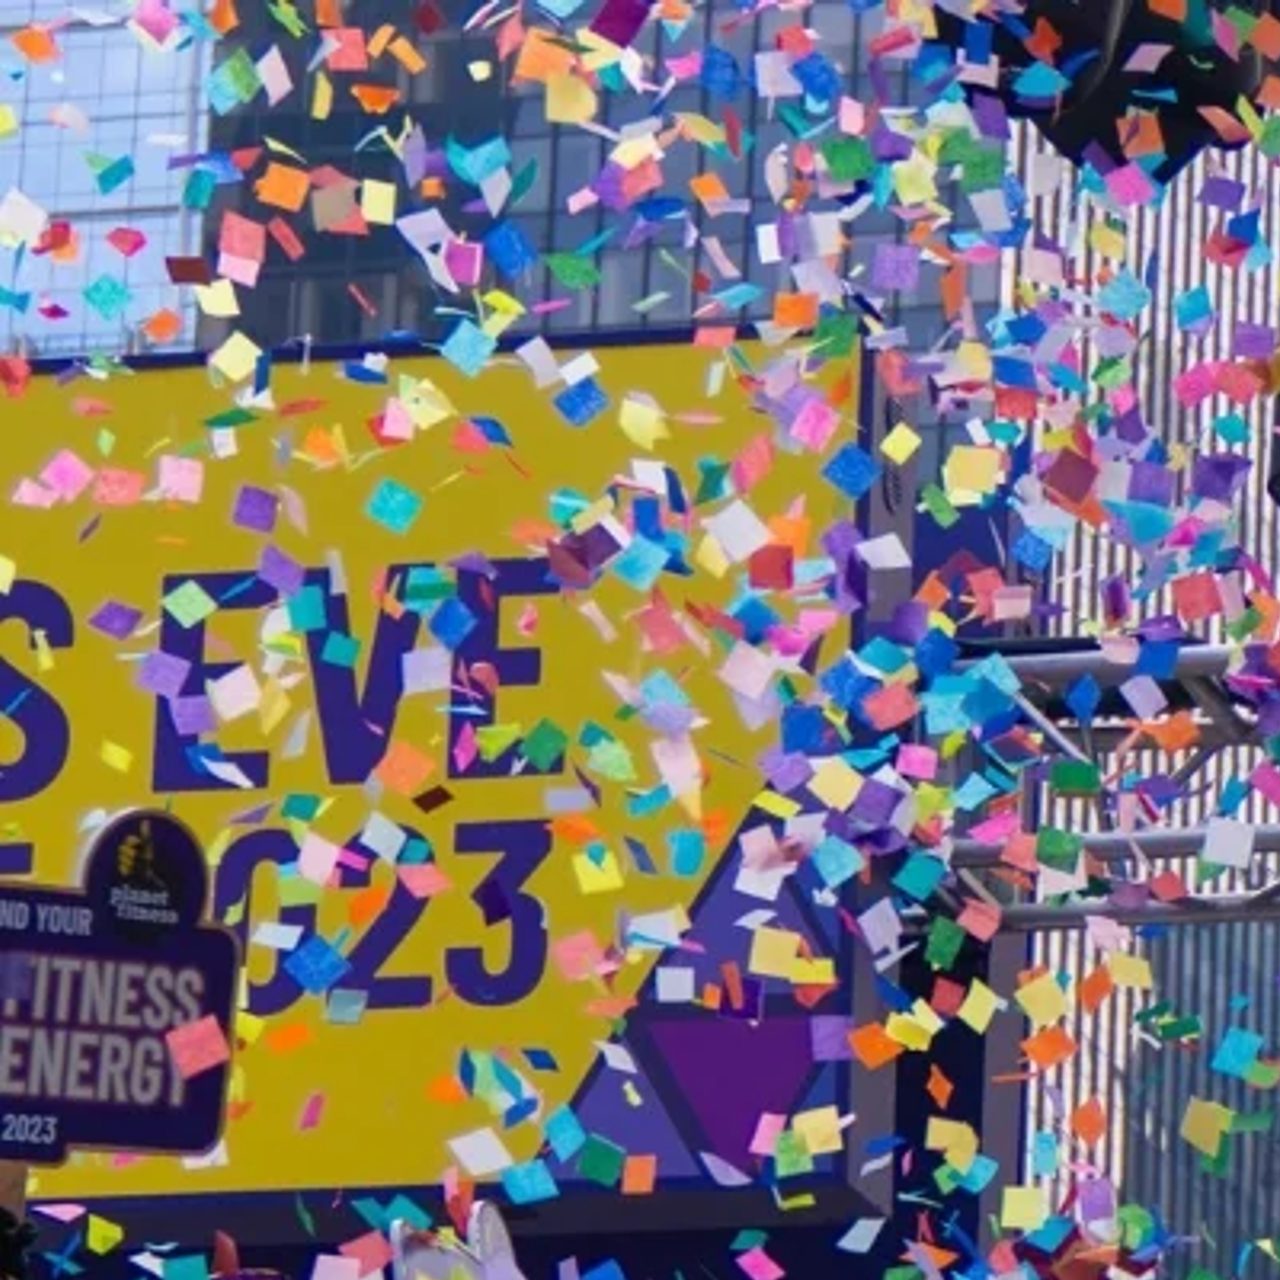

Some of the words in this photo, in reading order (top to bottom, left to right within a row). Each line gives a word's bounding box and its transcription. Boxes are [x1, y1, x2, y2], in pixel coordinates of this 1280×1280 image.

[153, 556, 563, 792] EVE
[110, 884, 170, 905] planet
[36, 903, 92, 936] YOUR
[115, 904, 179, 924] fitness
[206, 818, 553, 1017] 023
[3, 951, 205, 1030] ITNESS
[2, 1113, 58, 1144] 2023
